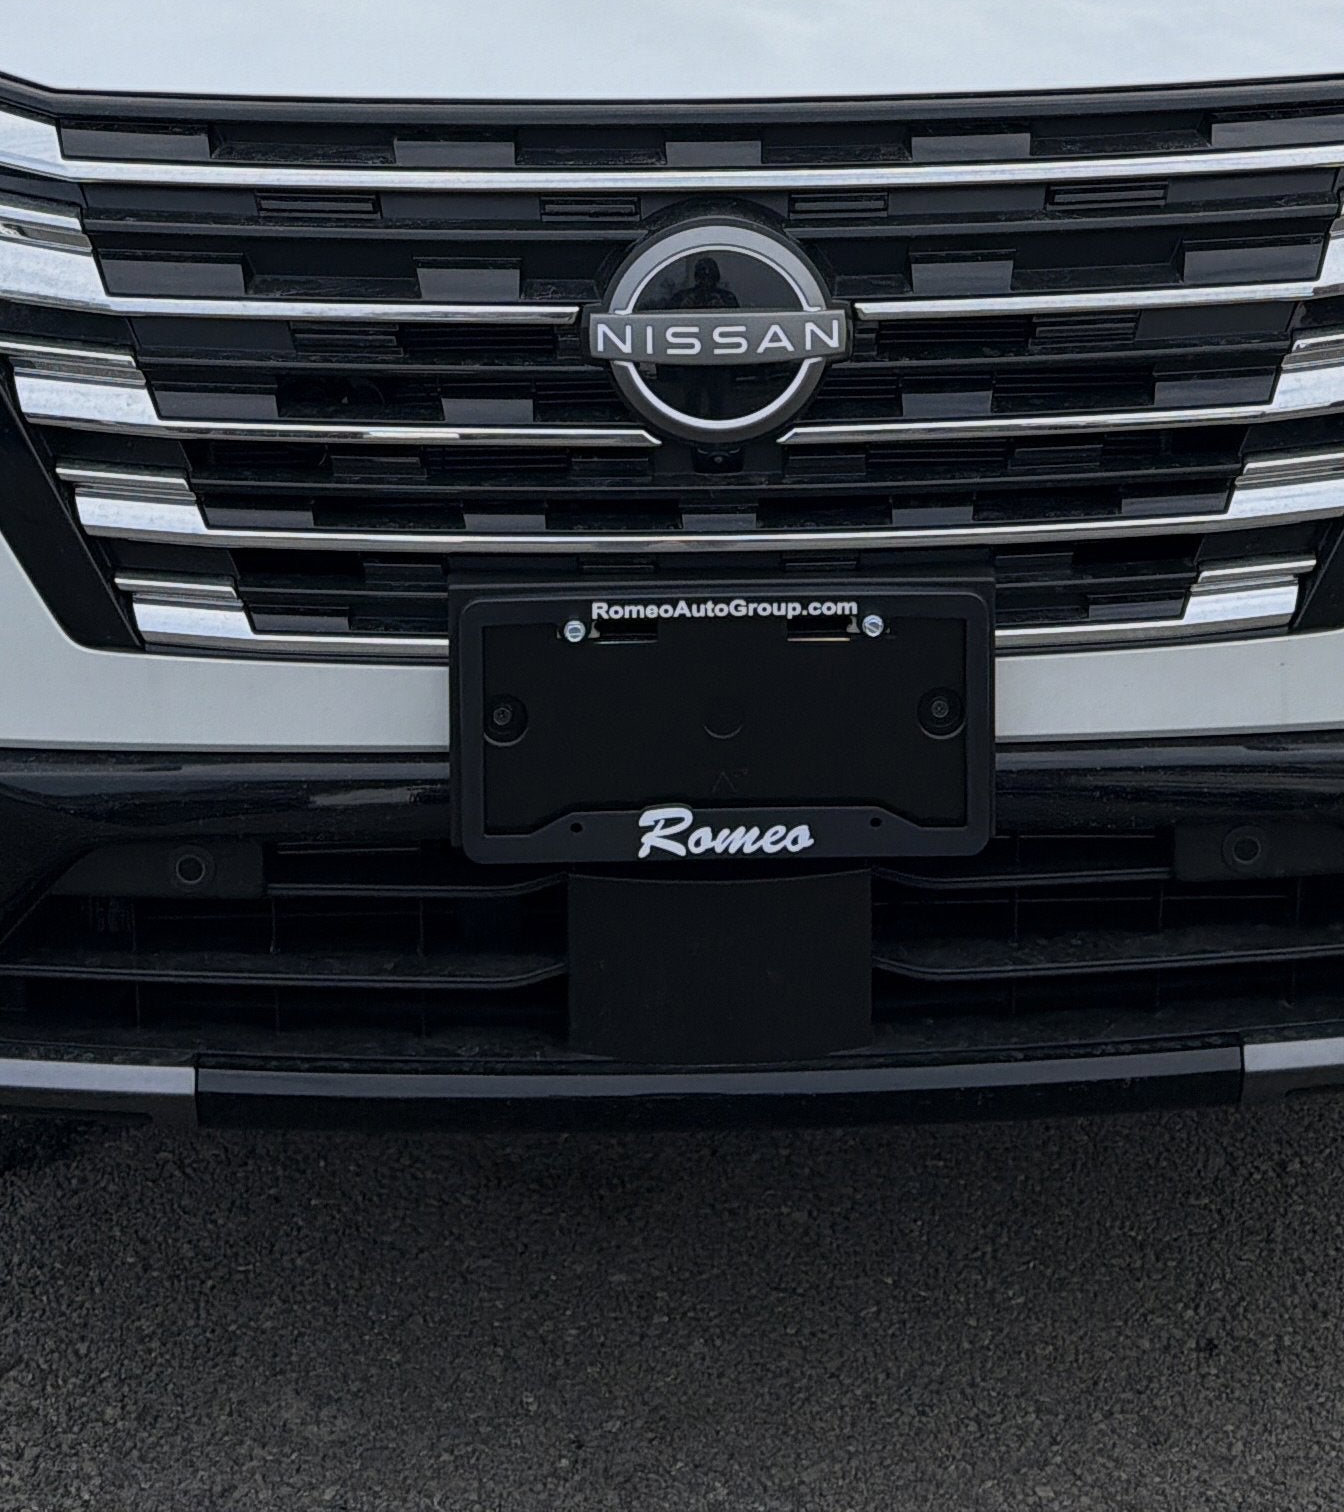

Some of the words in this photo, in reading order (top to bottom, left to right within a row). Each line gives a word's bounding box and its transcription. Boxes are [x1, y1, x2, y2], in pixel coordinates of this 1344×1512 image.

[597, 320, 840, 355] NISSAN
[591, 599, 857, 619] RomeoAutoGroup.com
[638, 806, 815, 859] Romeo
